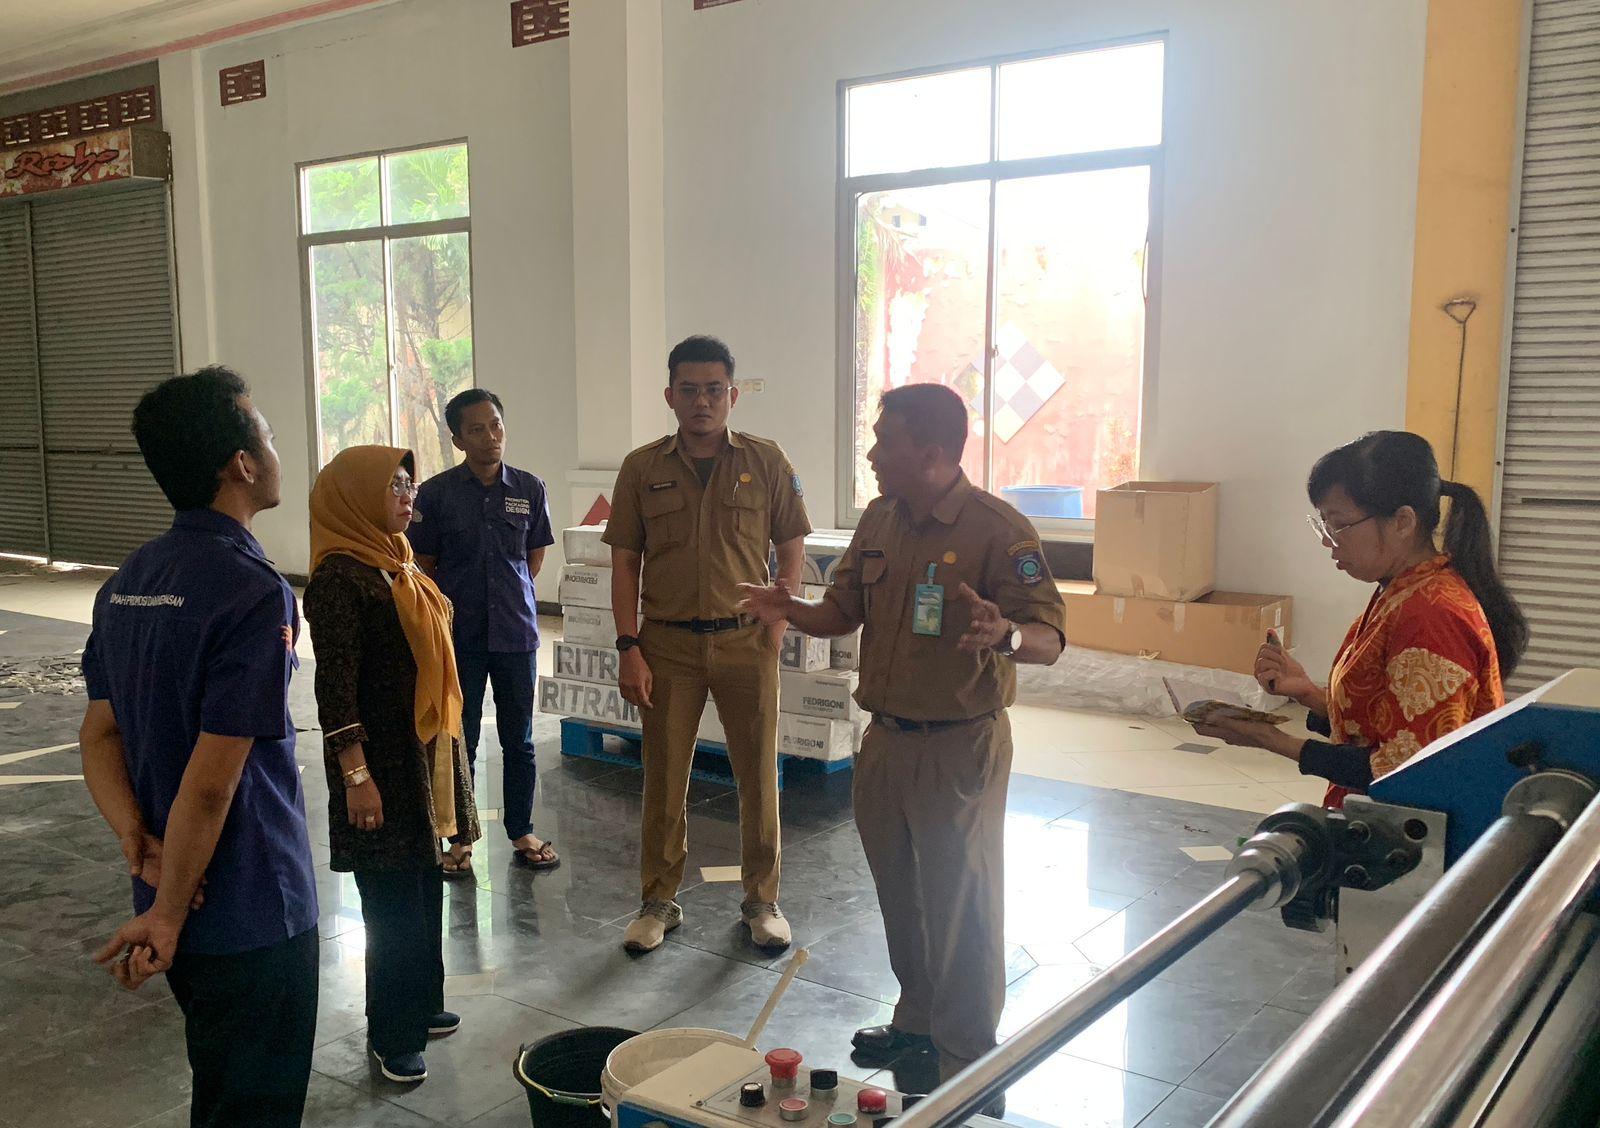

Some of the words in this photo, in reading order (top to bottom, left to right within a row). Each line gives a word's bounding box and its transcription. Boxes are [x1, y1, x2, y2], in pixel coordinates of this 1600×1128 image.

[505, 506, 529, 514] DESIGN
[557, 645, 617, 681] RITR
[802, 696, 844, 709] FEDRIGONI
